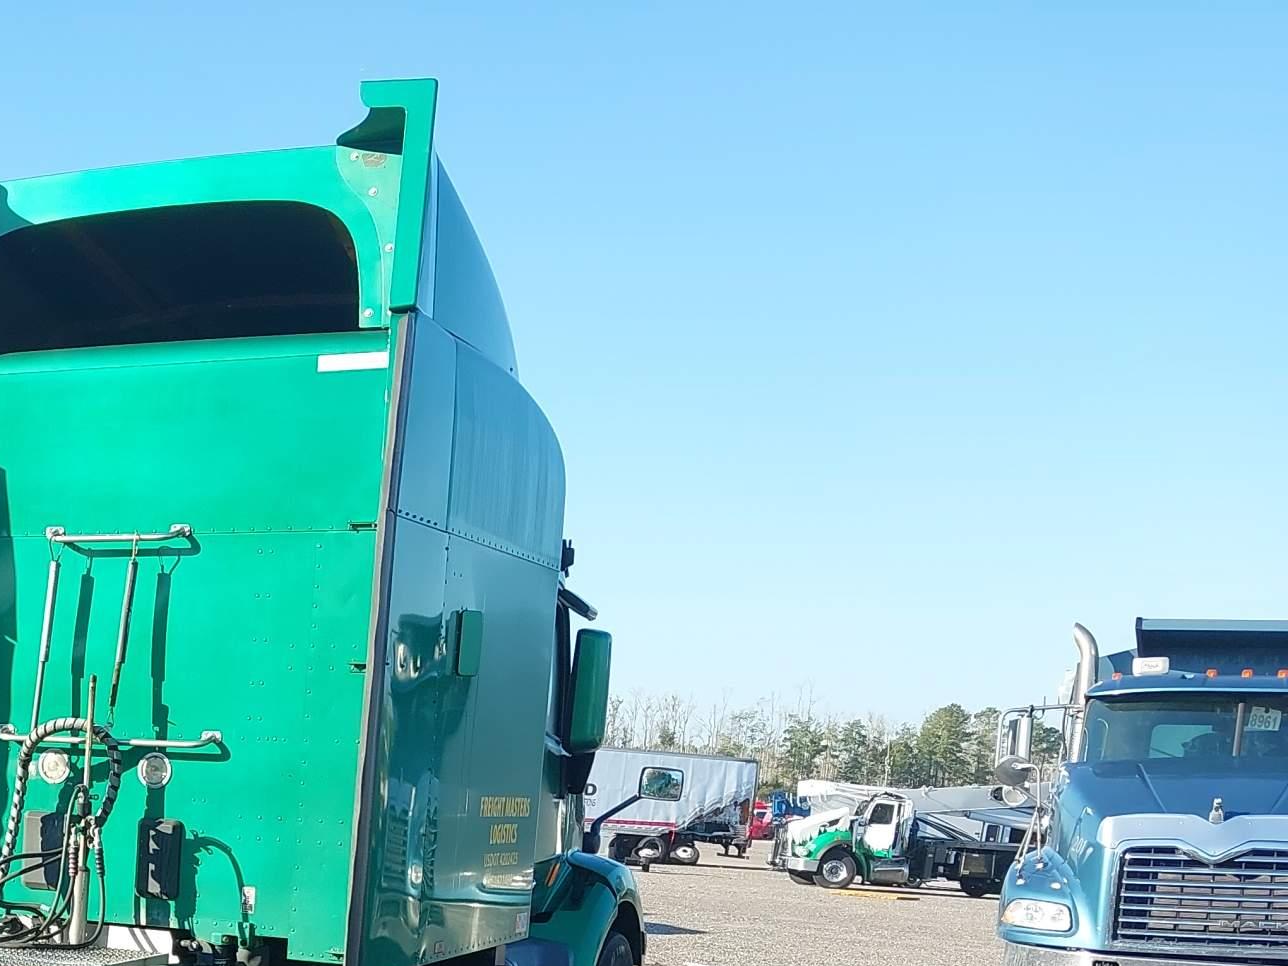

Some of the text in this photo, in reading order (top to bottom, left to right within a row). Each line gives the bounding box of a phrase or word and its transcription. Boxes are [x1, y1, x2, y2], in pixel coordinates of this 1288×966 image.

[1250, 713, 1279, 729] 8961
[479, 796, 531, 817] FREIGHT MASTERS
[489, 823, 518, 845] LOGISTICS
